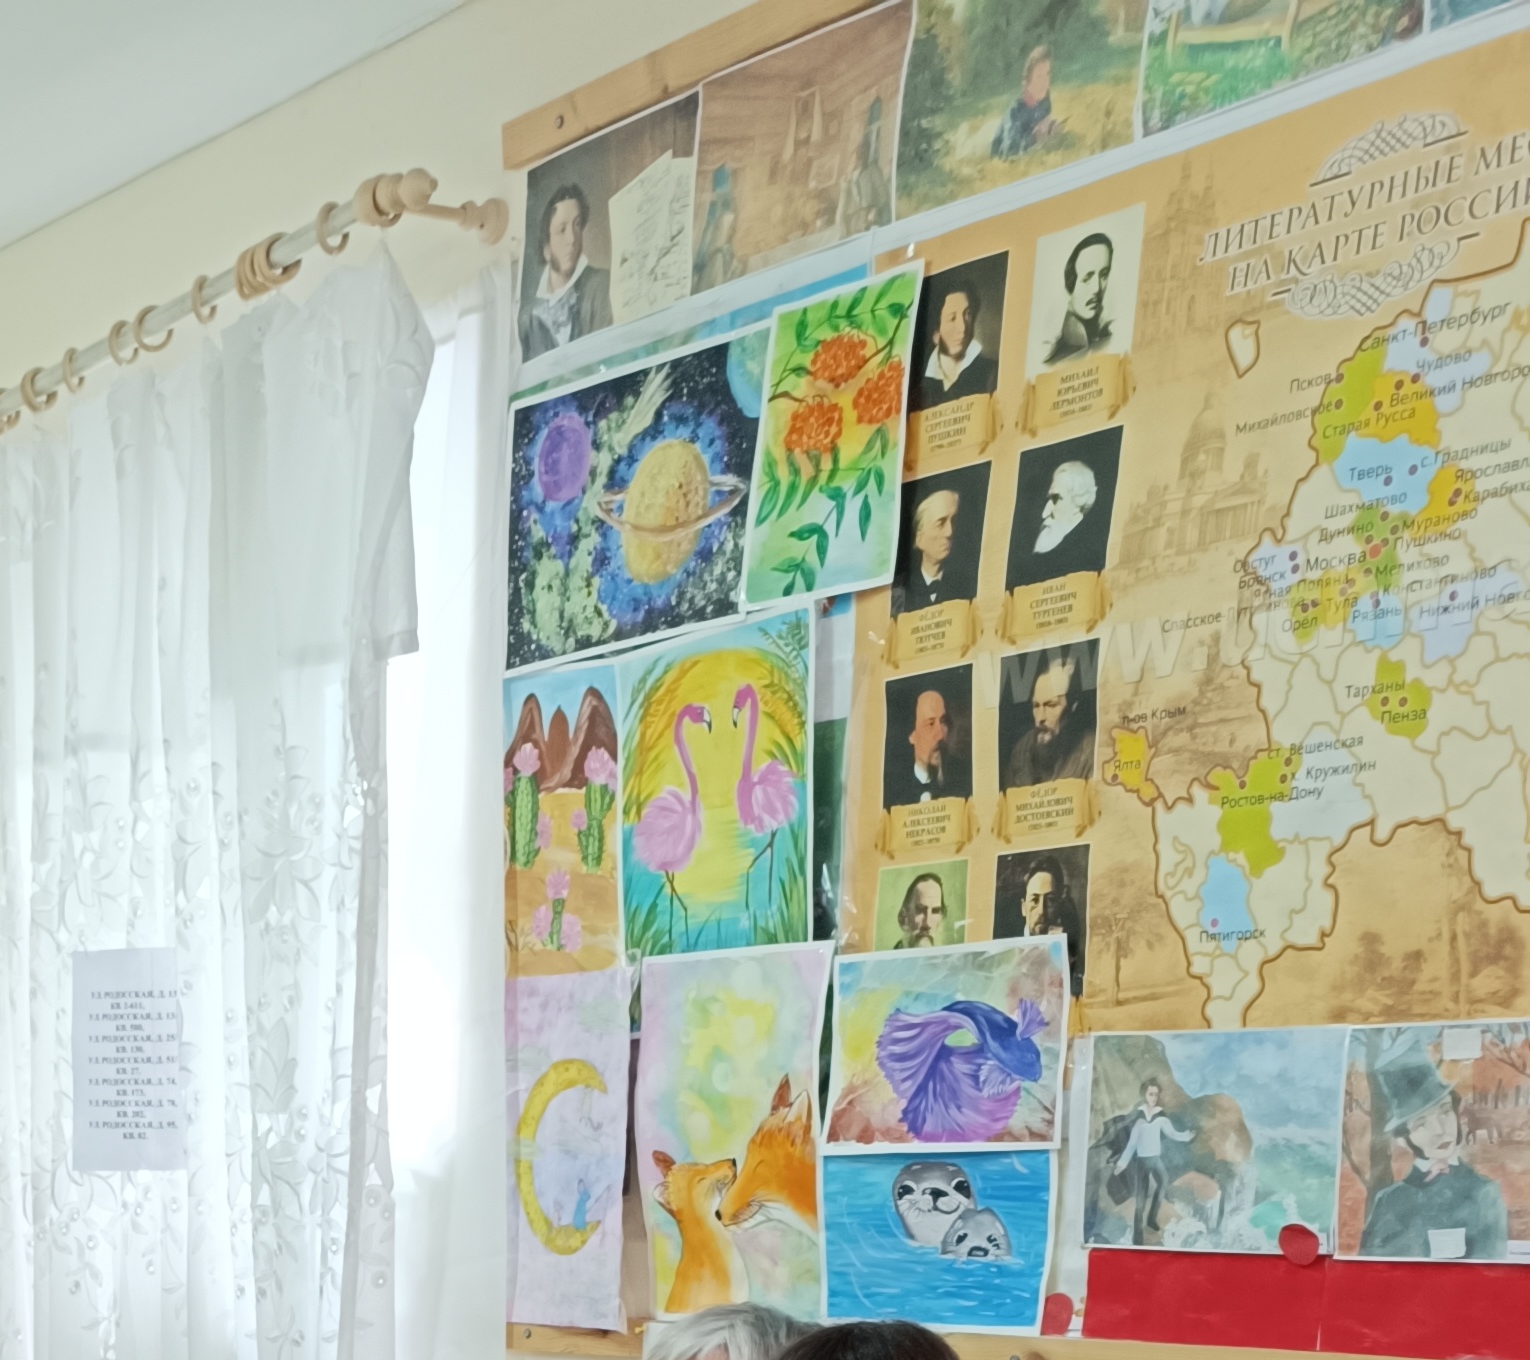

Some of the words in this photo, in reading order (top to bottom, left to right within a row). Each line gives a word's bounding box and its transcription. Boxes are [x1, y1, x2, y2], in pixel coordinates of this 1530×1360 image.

[1199, 153, 1464, 262] ЛИТЕРАТУРНЫЕ
[1473, 131, 1530, 176] МЕ
[1228, 257, 1271, 292] НА
[1285, 220, 1387, 277] КАРТЕ
[1357, 302, 1511, 353] Санкт-Петербург
[1416, 350, 1472, 373] Чудово
[1289, 372, 1332, 394] Псков
[1389, 381, 1457, 408] Великий
[1235, 400, 1333, 436] Михайловское
[1322, 417, 1370, 440] Старая
[1375, 406, 1417, 430] Русса
[1348, 463, 1393, 484] Тверь
[1324, 492, 1407, 520] Шахматово
[1318, 520, 1374, 545] Дунино
[1401, 508, 1478, 534] Мураново
[1393, 528, 1462, 553] Пушкино
[1305, 551, 1367, 572] Москва
[1375, 554, 1449, 579] Мелихово
[1326, 595, 1358, 614] Тула
[1352, 607, 1402, 624] Рязань
[1420, 596, 1480, 620] Нижний
[1282, 615, 1318, 634] Орёл
[1345, 681, 1405, 699] Тарханы
[1151, 704, 1187, 722] Крым
[1381, 708, 1427, 725] Пенза
[1289, 735, 1364, 757] Вёшенская
[1113, 758, 1141, 771] Ялта
[1306, 760, 1377, 783] Кружилин
[1221, 784, 1325, 809] Ростов-на-Дону
[1199, 927, 1266, 945] Пятигорск
